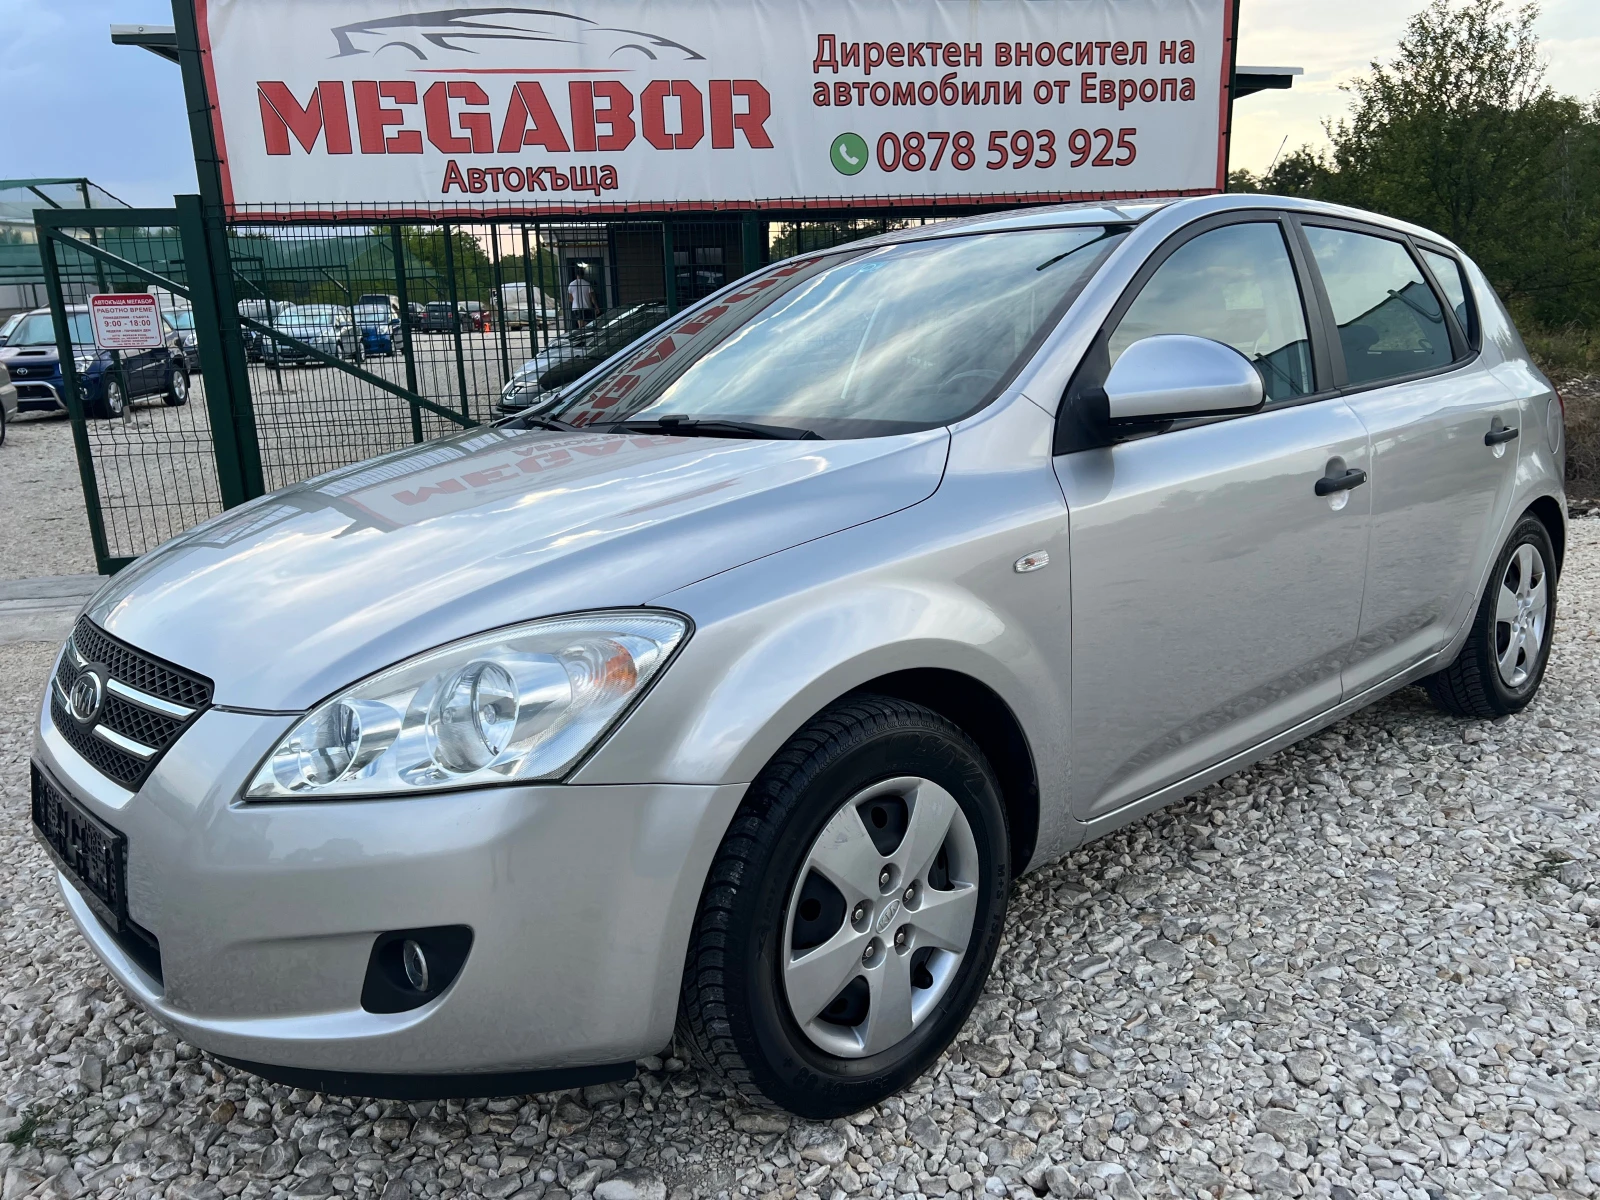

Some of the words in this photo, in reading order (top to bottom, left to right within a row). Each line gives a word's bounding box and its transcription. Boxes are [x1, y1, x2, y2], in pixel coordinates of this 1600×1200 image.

[813, 34, 982, 75] Директен
[994, 40, 1147, 67] вносител
[1159, 39, 1195, 65] на
[813, 73, 1022, 107] автомобили
[1033, 80, 1070, 104] от
[1080, 72, 1195, 110] Европа
[256, 79, 774, 155] MEGABOR
[876, 131, 976, 173] 0878
[986, 130, 1057, 170] 593
[1068, 128, 1137, 168] 925
[441, 159, 619, 196] Автокъща
[878, 900, 900, 930] KIA
